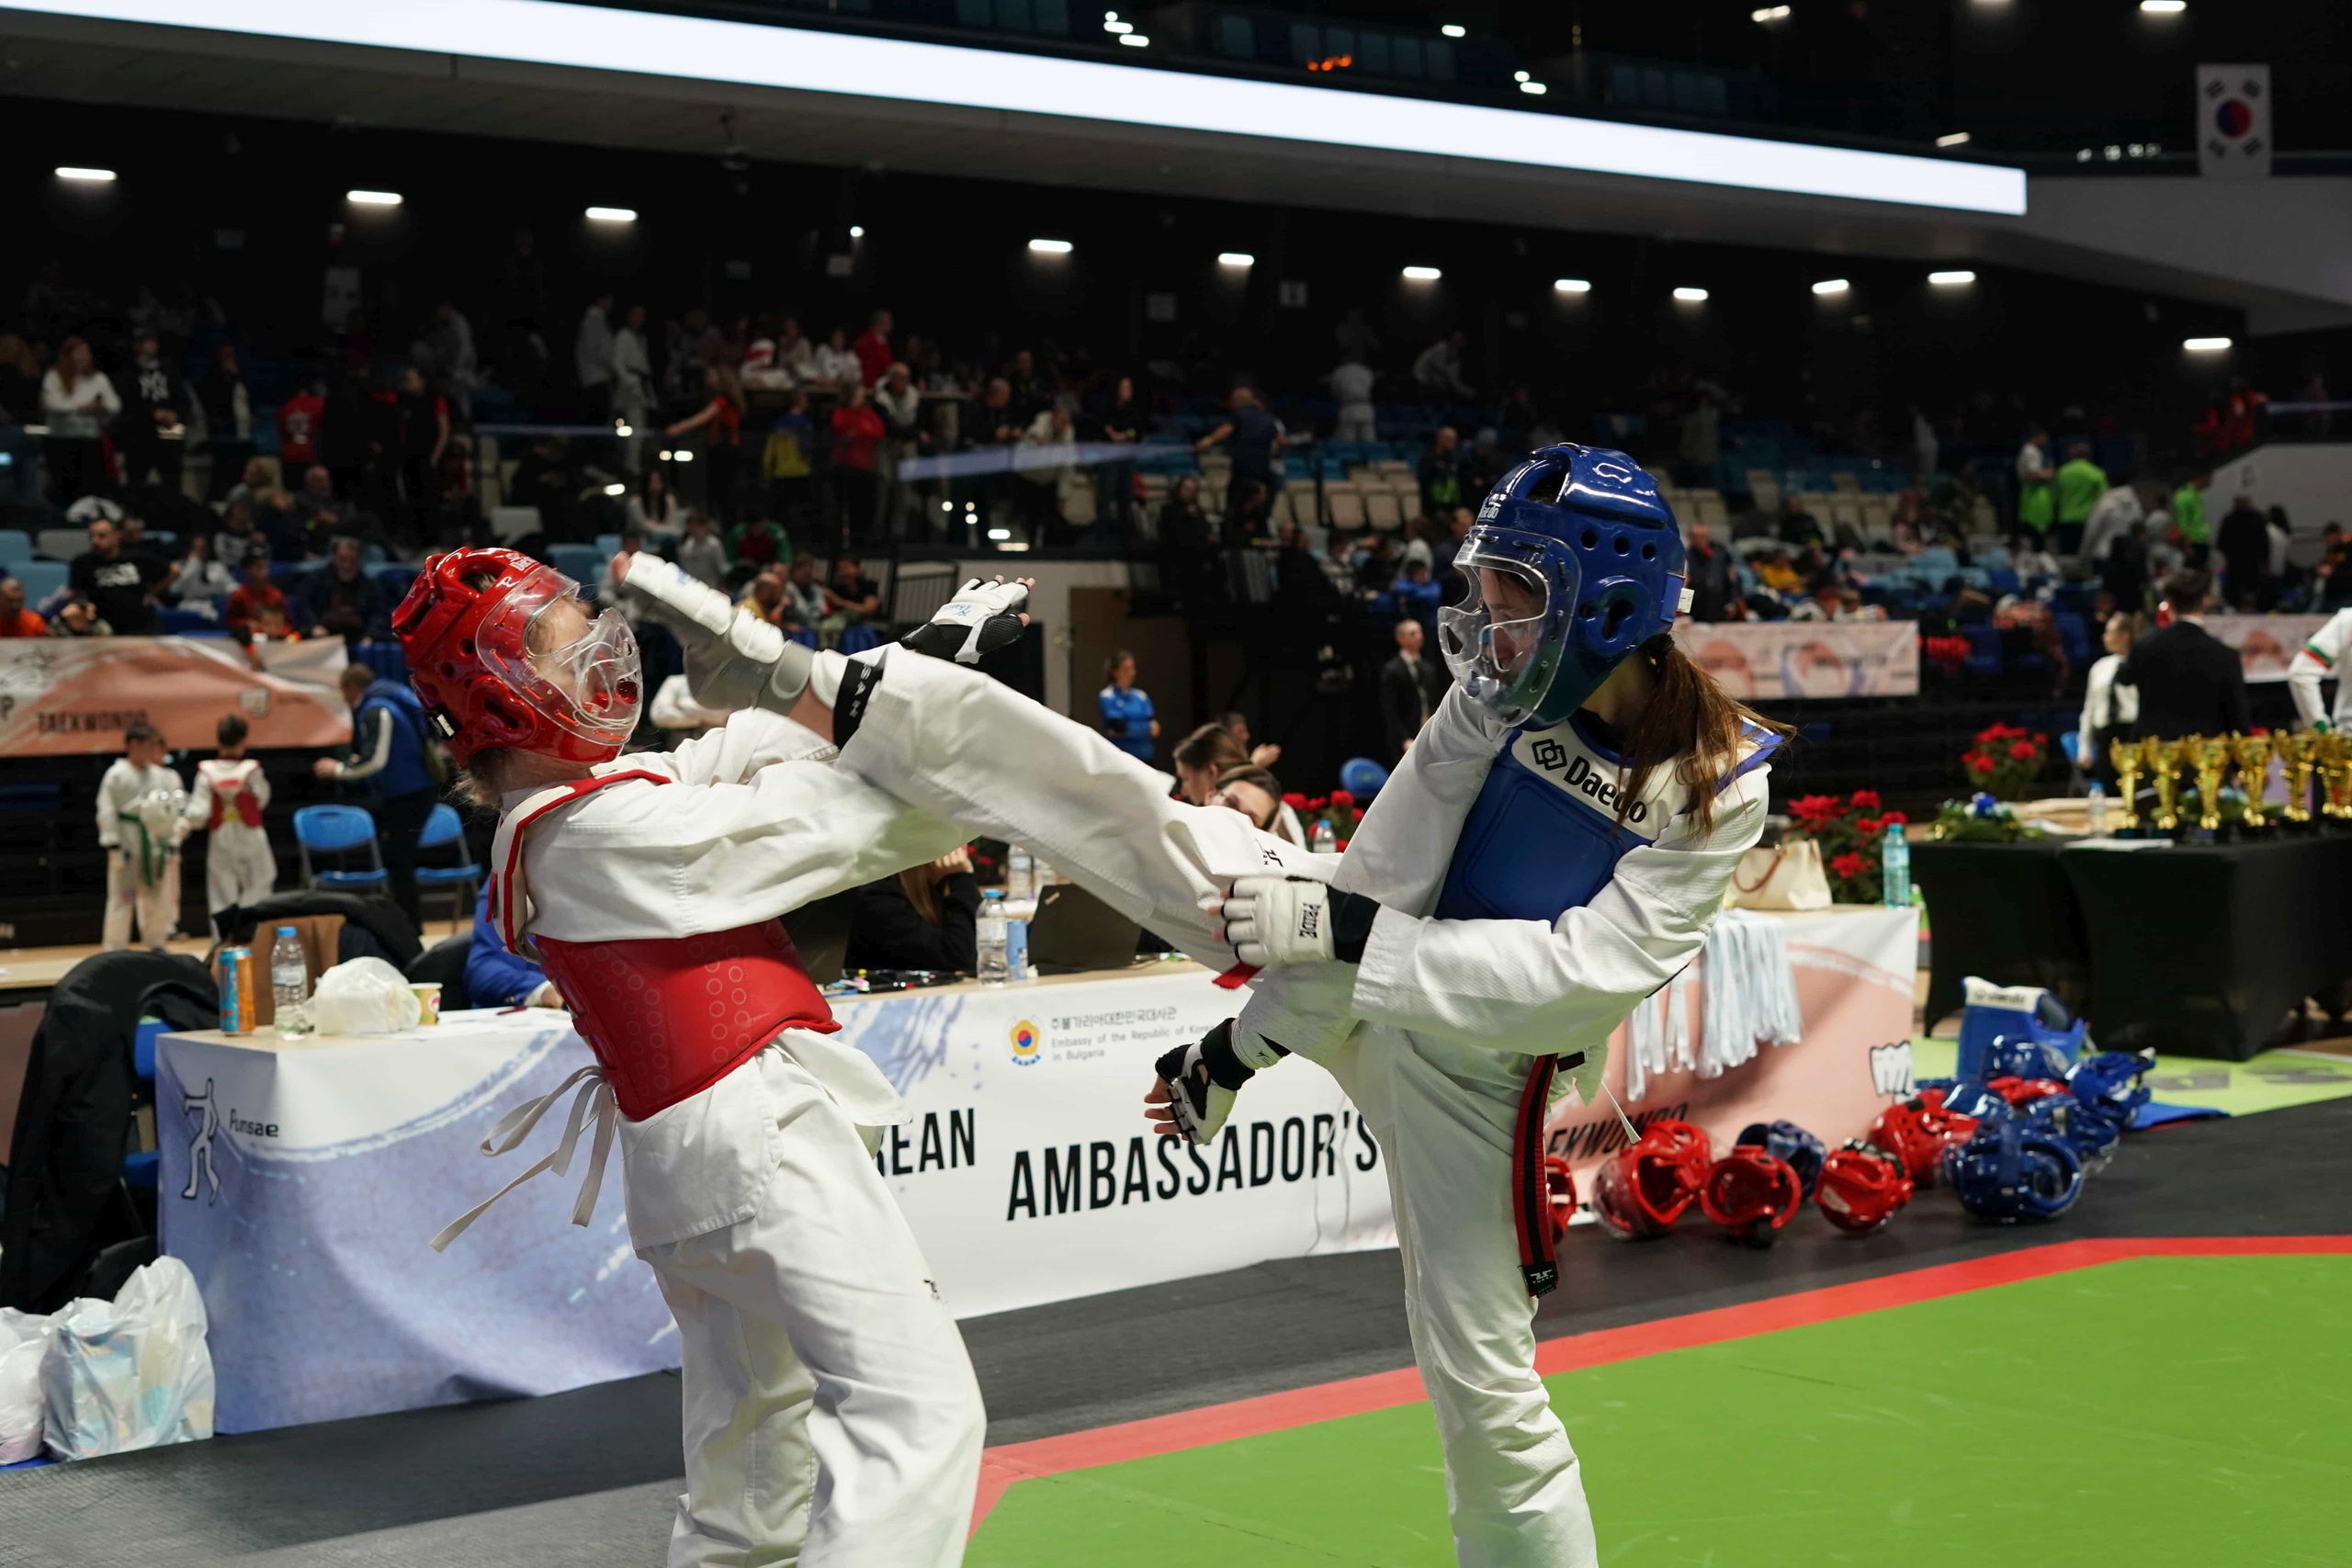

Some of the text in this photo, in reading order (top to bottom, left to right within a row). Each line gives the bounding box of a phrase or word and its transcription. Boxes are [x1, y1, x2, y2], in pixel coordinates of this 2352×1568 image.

[1052, 1034, 1092, 1049] Embassy
[1097, 1032, 1107, 1043] of
[1111, 1031, 1126, 1043] the
[1131, 1027, 1170, 1041] Republic
[1175, 1024, 1184, 1036] of
[1052, 1050, 1062, 1062] in
[1067, 1049, 1105, 1063] Bulgaria
[1006, 1110, 1378, 1222] AMBASSADOR'S
